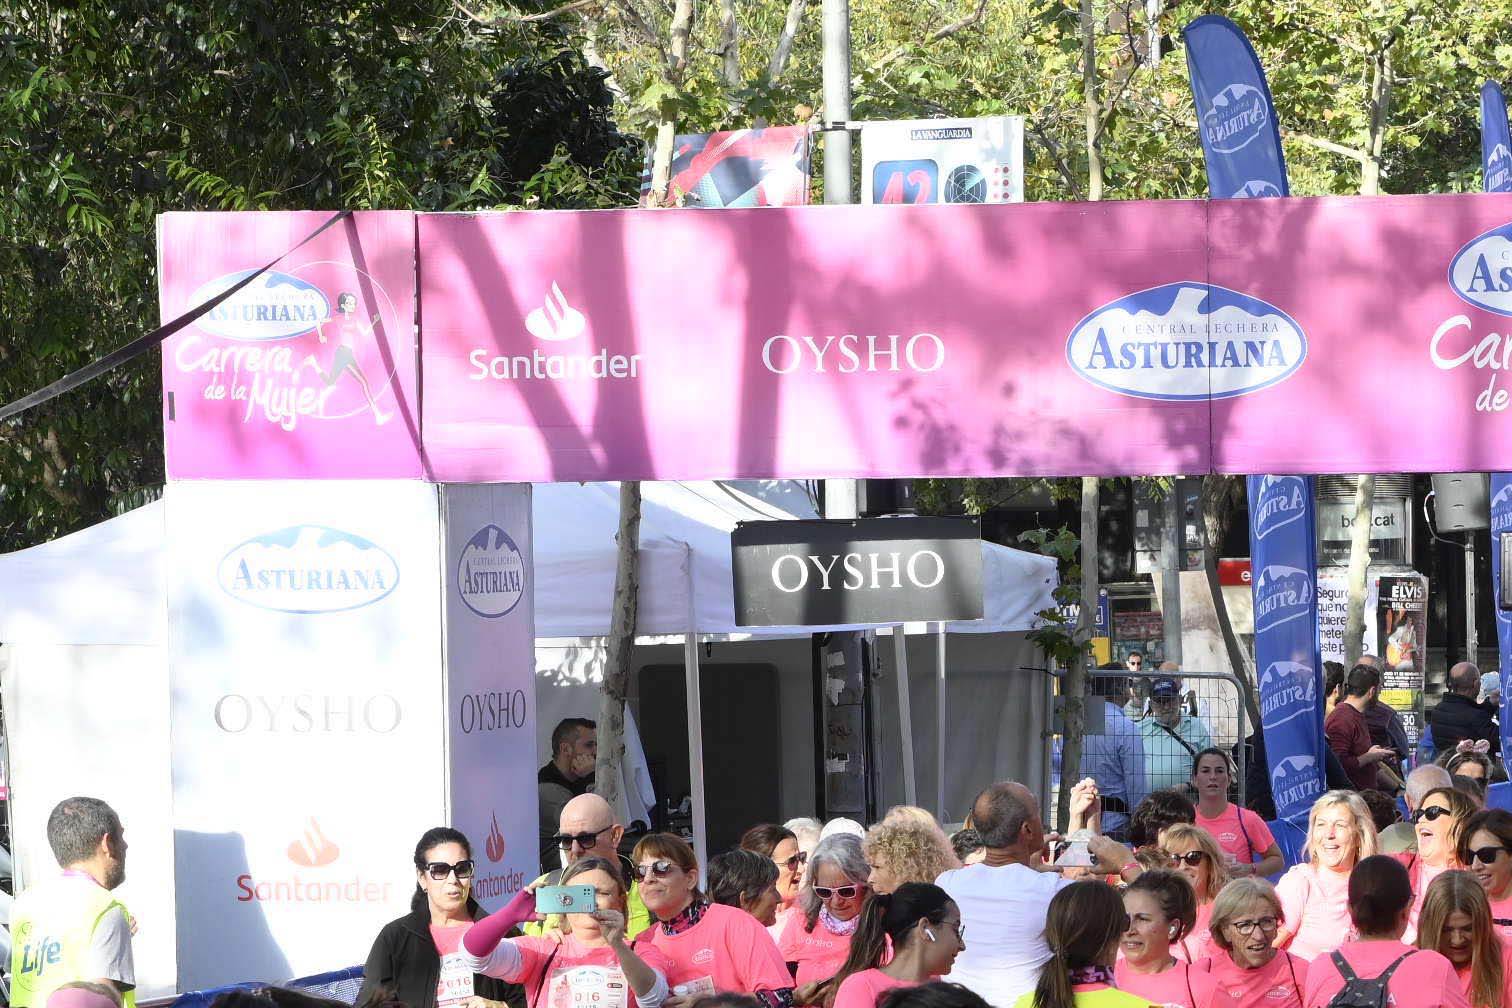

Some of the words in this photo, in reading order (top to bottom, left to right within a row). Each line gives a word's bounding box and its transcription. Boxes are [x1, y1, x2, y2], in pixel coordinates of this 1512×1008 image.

[1122, 322, 1197, 336] CENTRAL
[1204, 321, 1280, 335] LECHERA
[175, 335, 293, 372] Carrera
[469, 349, 642, 382] Santander
[761, 333, 945, 375] OYSHO
[1084, 327, 1288, 372] ASTURIANA
[203, 374, 226, 401] de
[231, 373, 247, 401] la
[244, 369, 336, 432] Mujer
[1475, 375, 1509, 412] de
[232, 557, 388, 592] ASTURIANA
[463, 560, 521, 596] ASTURIANA
[771, 550, 946, 594] OYSHO
[214, 692, 402, 734] OYSHO
[461, 689, 527, 734] OYSHO
[236, 874, 391, 903] Santander
[21, 936, 61, 977] Life
